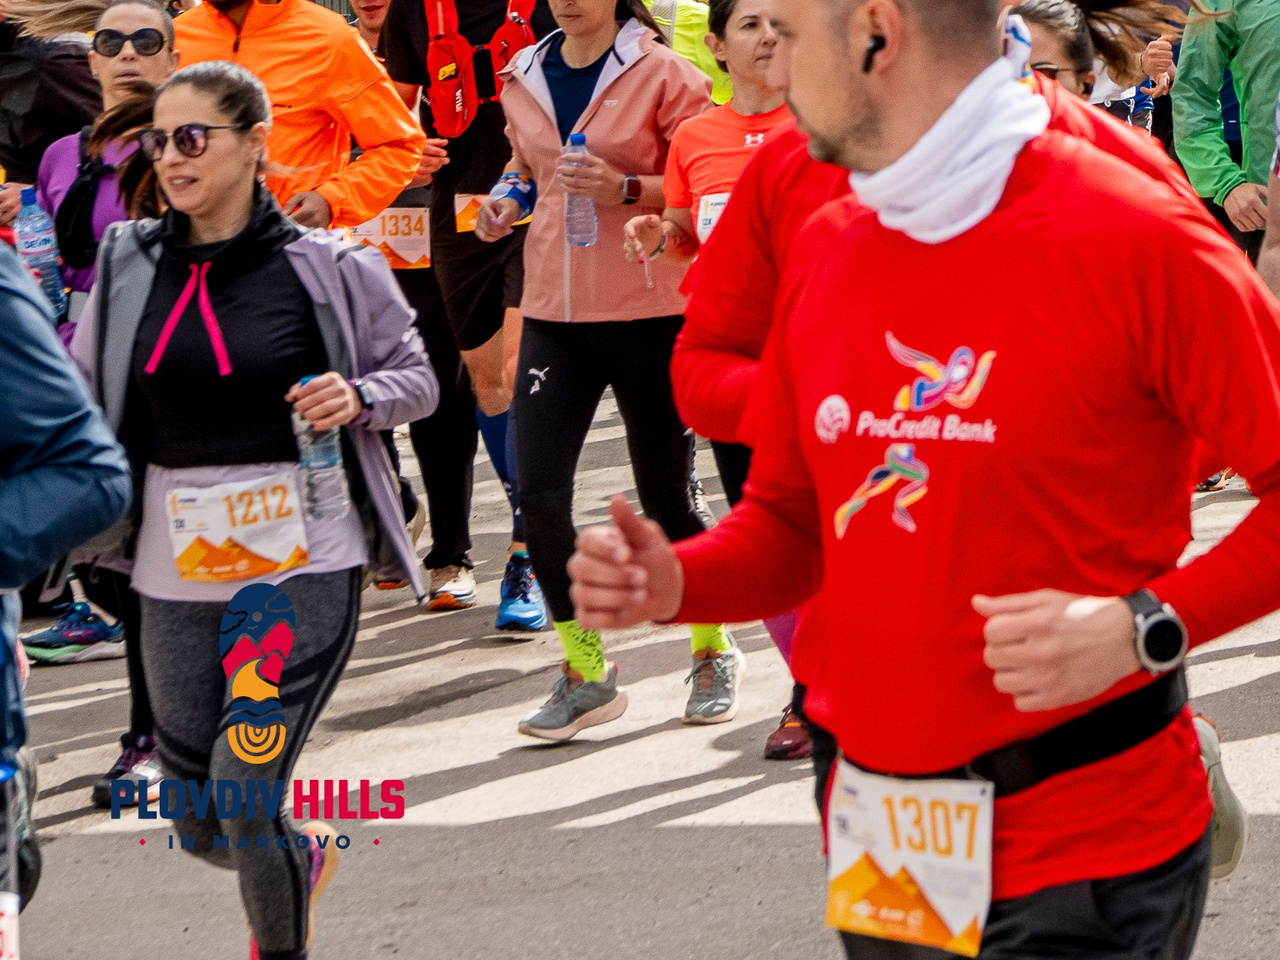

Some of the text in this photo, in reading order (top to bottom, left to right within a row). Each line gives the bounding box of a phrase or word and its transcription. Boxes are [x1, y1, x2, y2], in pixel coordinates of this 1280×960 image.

[379, 214, 426, 237] 1334
[855, 410, 997, 443] ProCredit Bank
[222, 484, 294, 528] 1212
[882, 795, 979, 861] 1307
